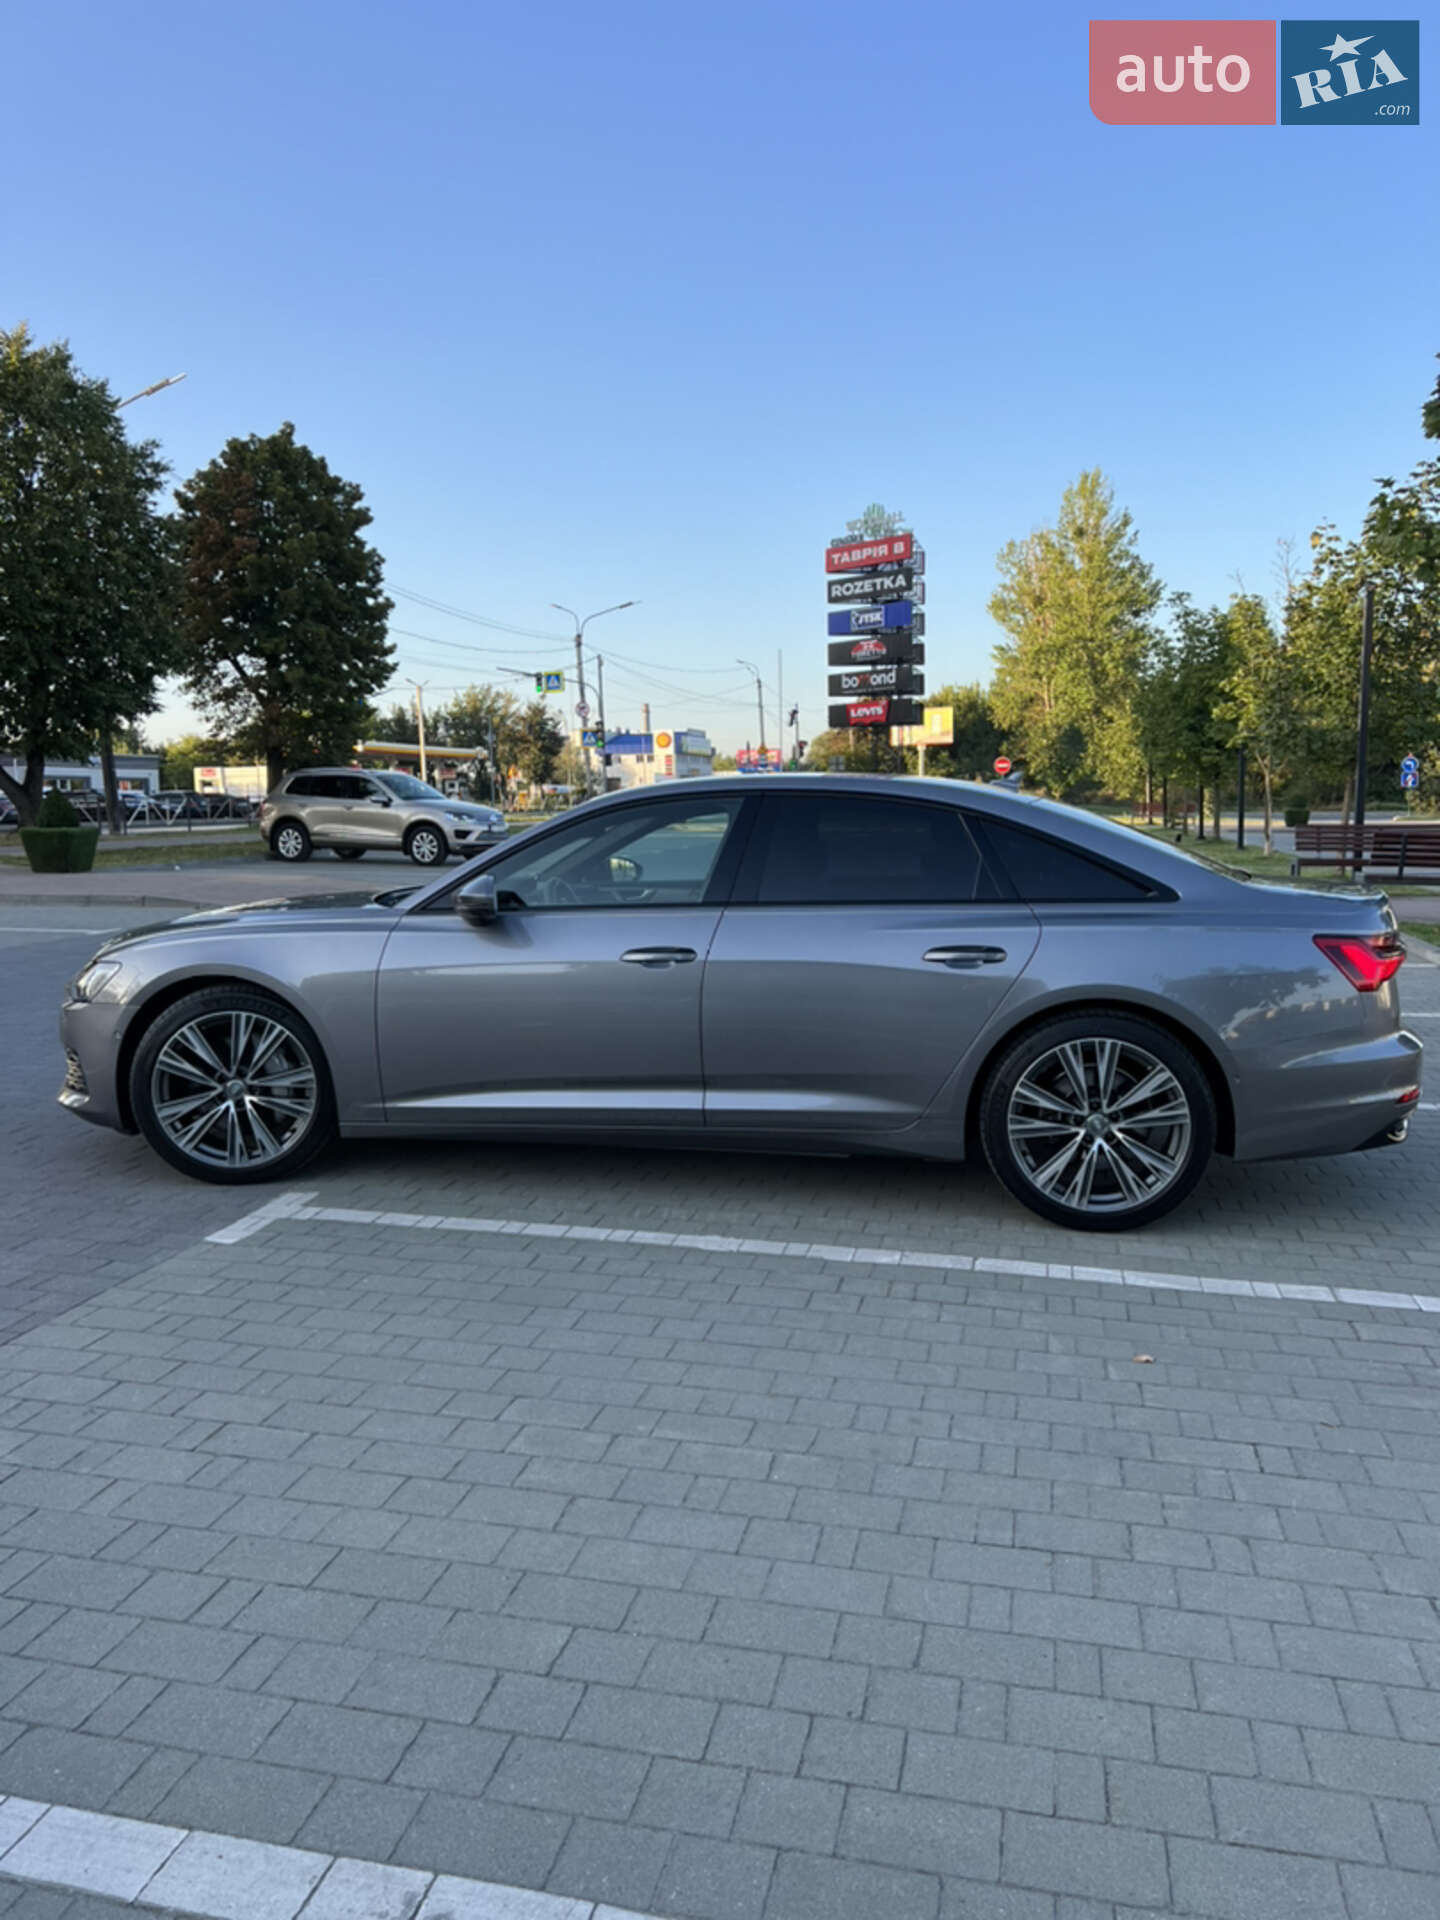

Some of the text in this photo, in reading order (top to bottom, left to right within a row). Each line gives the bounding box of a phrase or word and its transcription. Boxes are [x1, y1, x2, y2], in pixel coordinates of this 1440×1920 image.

[832, 541, 905, 565] ТАВРІЯ В
[831, 574, 907, 598] ROZETKA
